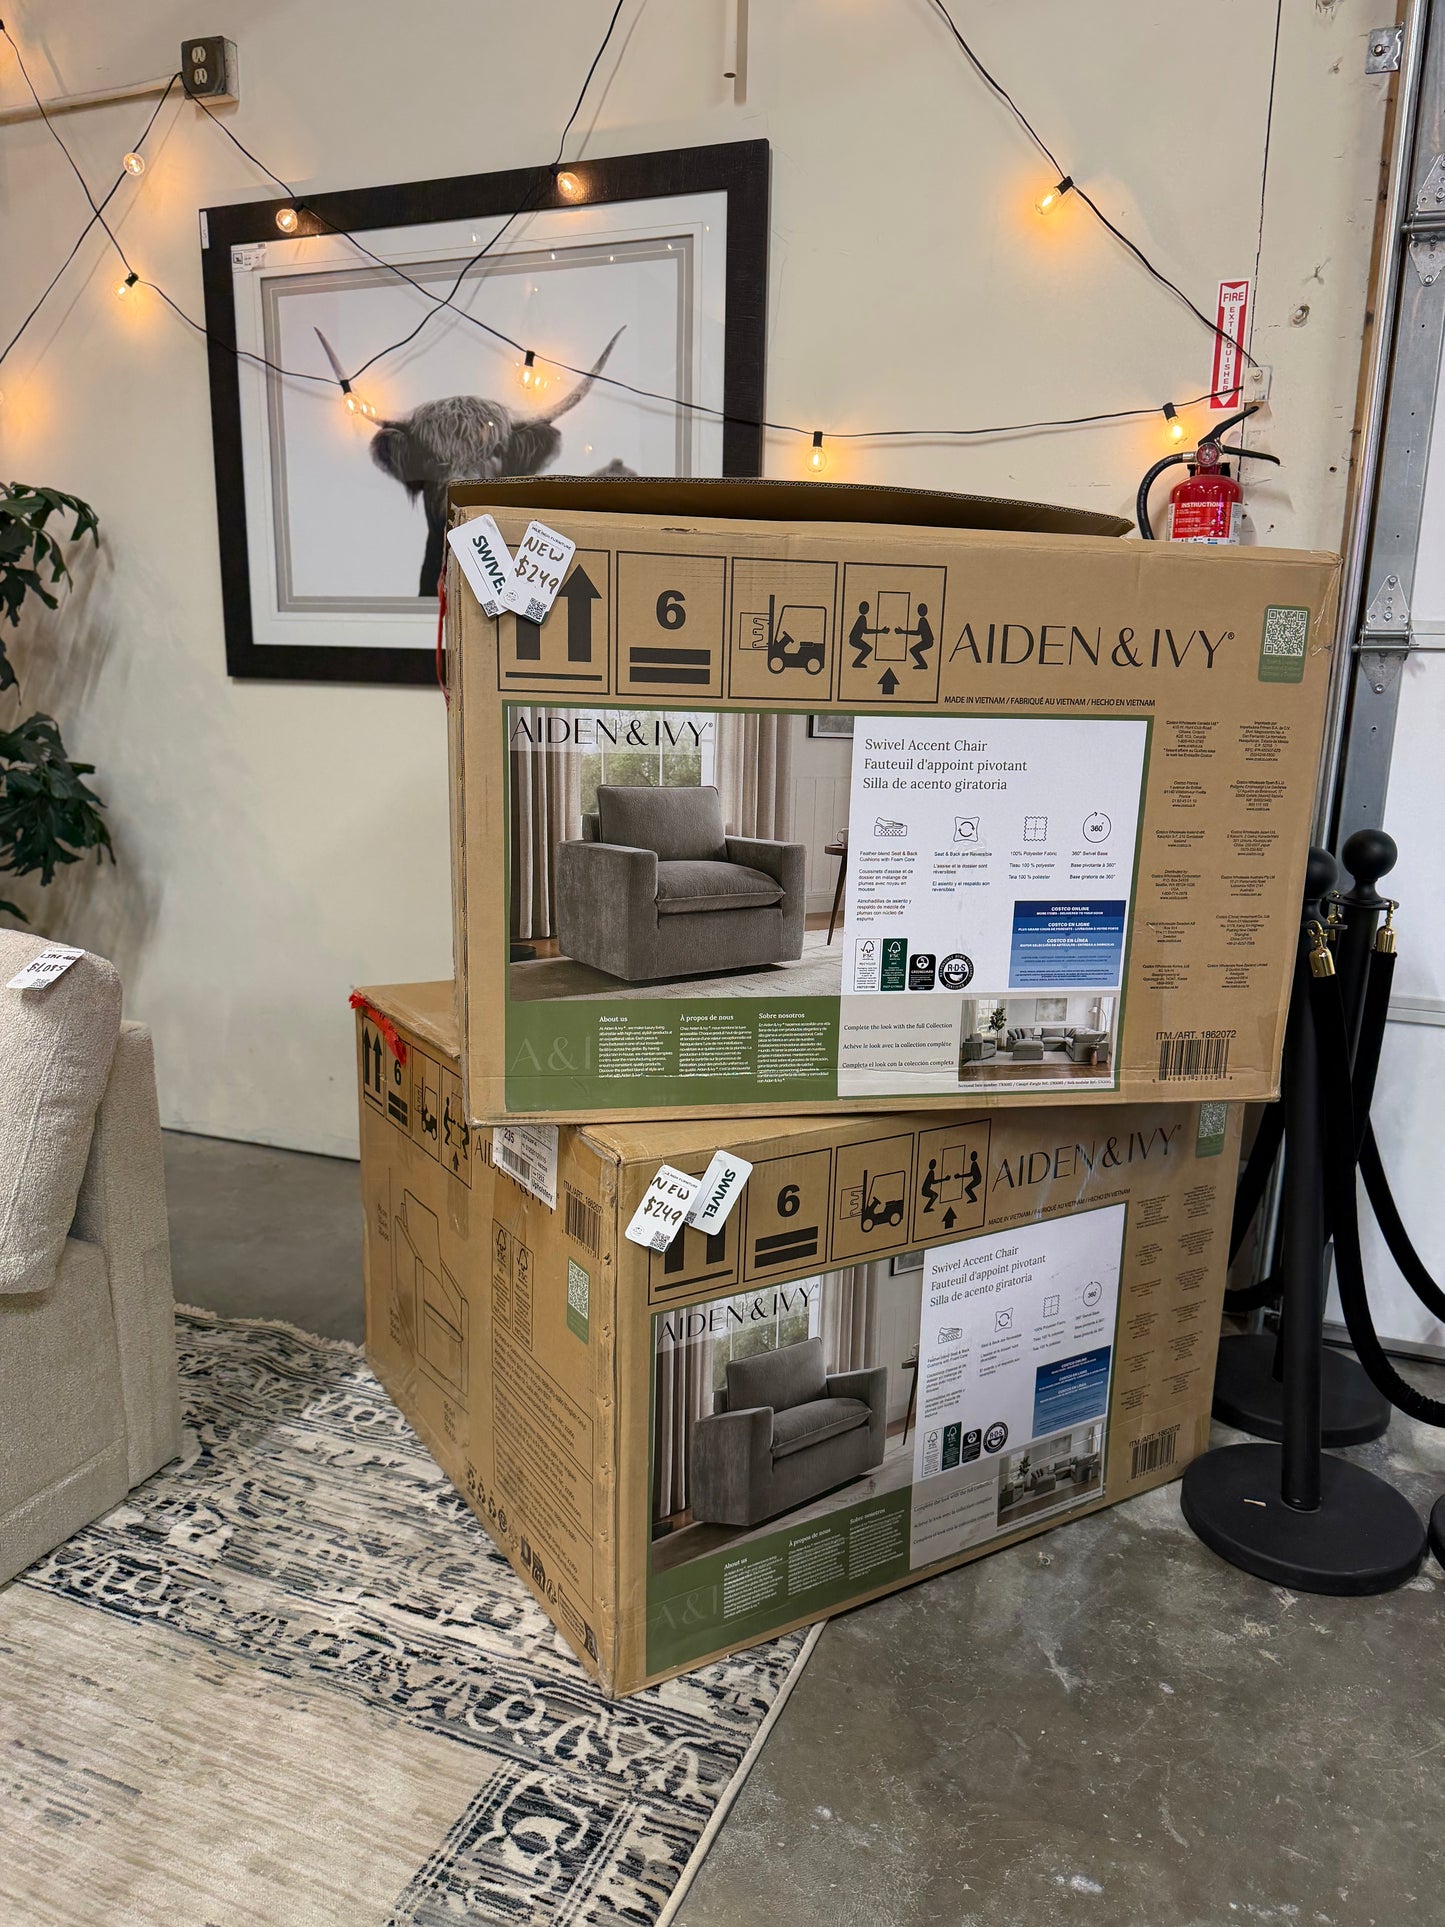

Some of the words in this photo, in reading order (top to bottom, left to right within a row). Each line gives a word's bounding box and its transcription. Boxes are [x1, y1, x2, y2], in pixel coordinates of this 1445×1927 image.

[1223, 292, 1244, 302] FIRE
[524, 536, 564, 561] NEW
[472, 535, 506, 595] SWIVE
[514, 555, 559, 594] $249
[655, 590, 687, 630] 6
[944, 696, 965, 704] MADE
[1011, 697, 1043, 705] FABRIQUÉ
[865, 739, 905, 751] Swivel
[908, 740, 950, 751] Accent
[954, 740, 988, 751] Chair
[865, 759, 913, 770] Fauteuil
[917, 760, 974, 773] d'appoint
[977, 761, 1027, 773] pivotant
[863, 778, 889, 789] Silla
[892, 779, 907, 790] de
[910, 780, 951, 790] acento
[954, 779, 1007, 793] giratoria
[1156, 1031, 1197, 1040] ITM./ART.
[1201, 1030, 1236, 1038] 1862072
[394, 1059, 401, 1086] 6
[652, 1177, 689, 1200] NEW
[702, 1169, 736, 1218] SWIVEL
[777, 1184, 800, 1217] 6
[644, 1196, 682, 1225] $249
[1010, 1211, 1030, 1220] VIETNAM
[1088, 1194, 1104, 1203] HECHO
[1111, 1188, 1131, 1198] VIETNAM
[931, 1261, 961, 1275] Swivel
[962, 1254, 993, 1268] Accent
[995, 1246, 1019, 1260] Chair
[931, 1274, 967, 1291] Fauteuil
[969, 1264, 1009, 1282] d'appoint
[1011, 1255, 1046, 1273] pivotant
[930, 1293, 949, 1307] Silla
[951, 1291, 962, 1301] de
[964, 1284, 993, 1299] acento
[995, 1273, 1032, 1292] giratoria
[850, 1515, 863, 1525] Sobre
[796, 1533, 811, 1546] propos
[812, 1531, 818, 1539] de
[819, 1527, 831, 1537] nous
[723, 1559, 740, 1570] About
